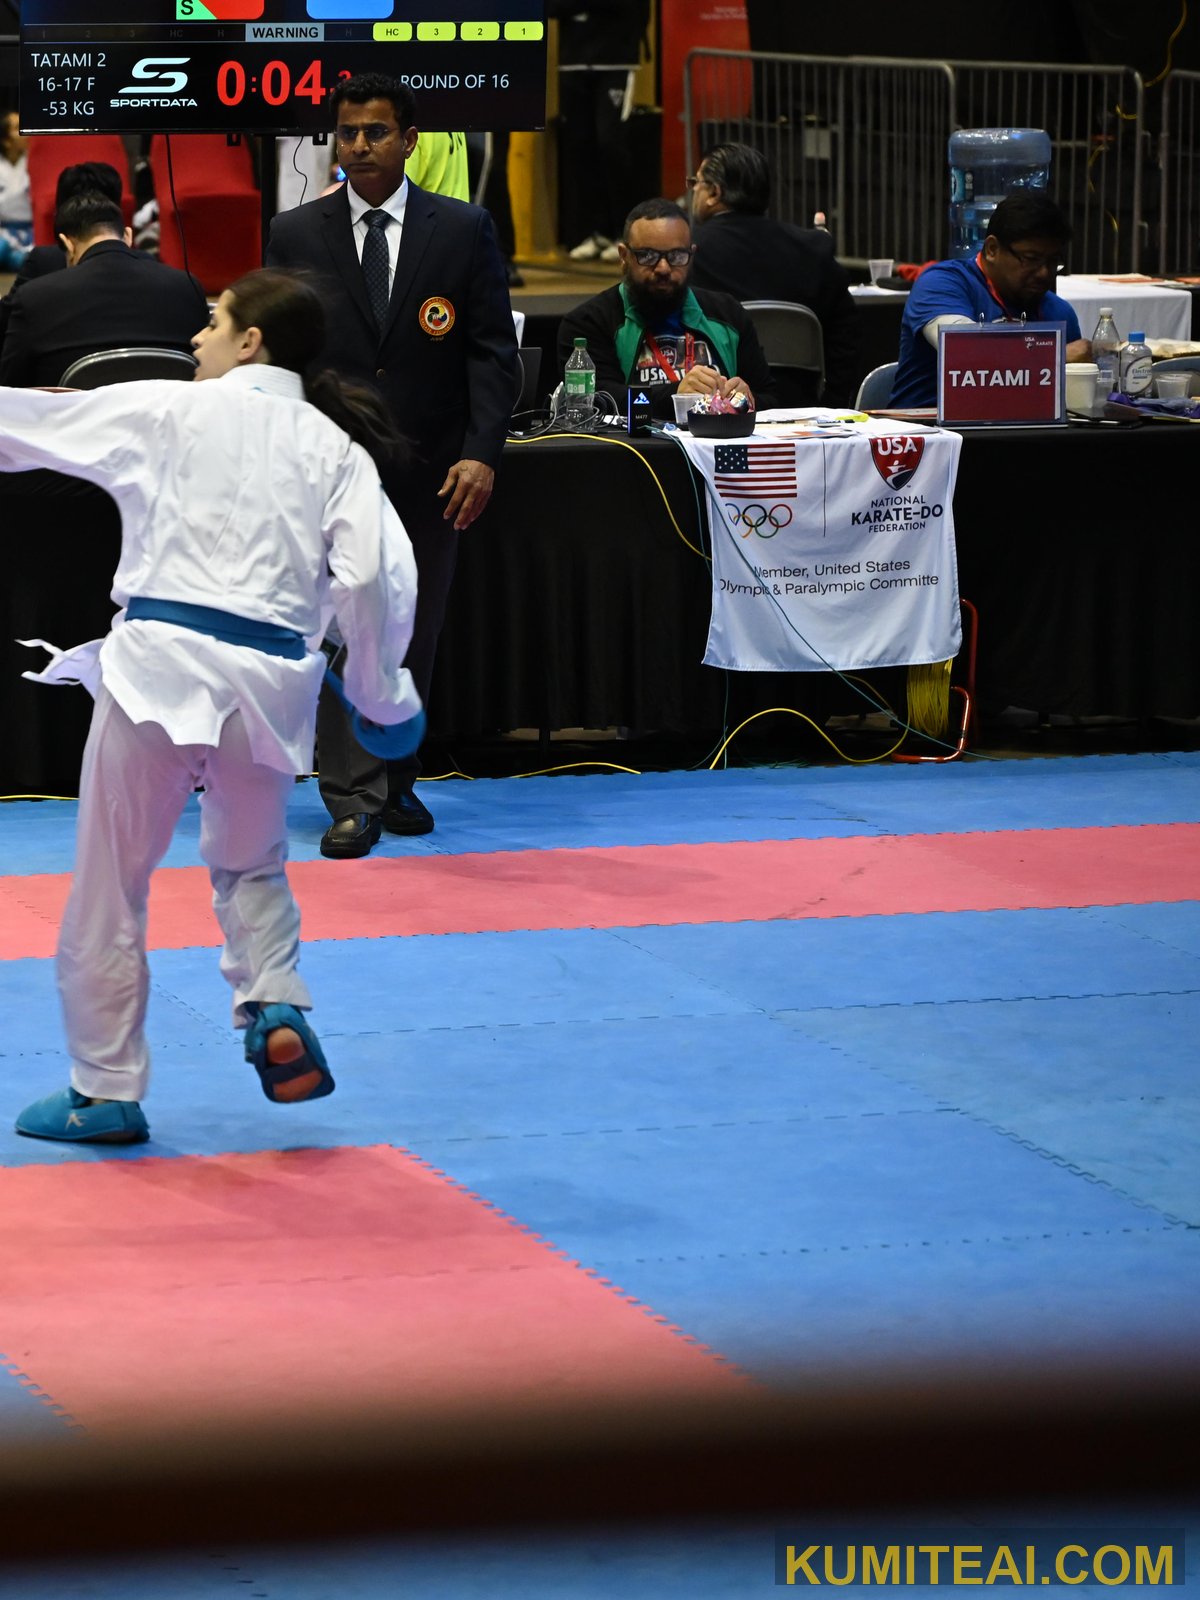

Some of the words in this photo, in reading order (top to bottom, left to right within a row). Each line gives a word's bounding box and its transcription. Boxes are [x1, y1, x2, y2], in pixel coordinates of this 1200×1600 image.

[181, 0, 194, 15] S
[253, 27, 319, 39] WARNING
[386, 28, 399, 36] HC
[434, 28, 439, 36] 3
[31, 54, 91, 67] TATAMI
[97, 53, 106, 67] 2
[38, 77, 82, 91] 16-17
[88, 77, 95, 91] F
[400, 74, 460, 89] ROUND
[465, 74, 486, 89] OF
[492, 74, 510, 89] 16
[43, 102, 67, 116] -53
[73, 101, 95, 115] KG
[110, 98, 198, 108] SPORTDATA
[949, 369, 1030, 387] TATAMI
[1039, 368, 1051, 386] 2
[877, 437, 918, 455] USA
[871, 495, 926, 508] NATIONAL
[851, 504, 943, 525] KARATE-DO
[869, 521, 926, 533] FEDERATION
[814, 563, 861, 576] United
[866, 561, 910, 573] States
[773, 583, 782, 595] &
[785, 578, 865, 596] Paralympic
